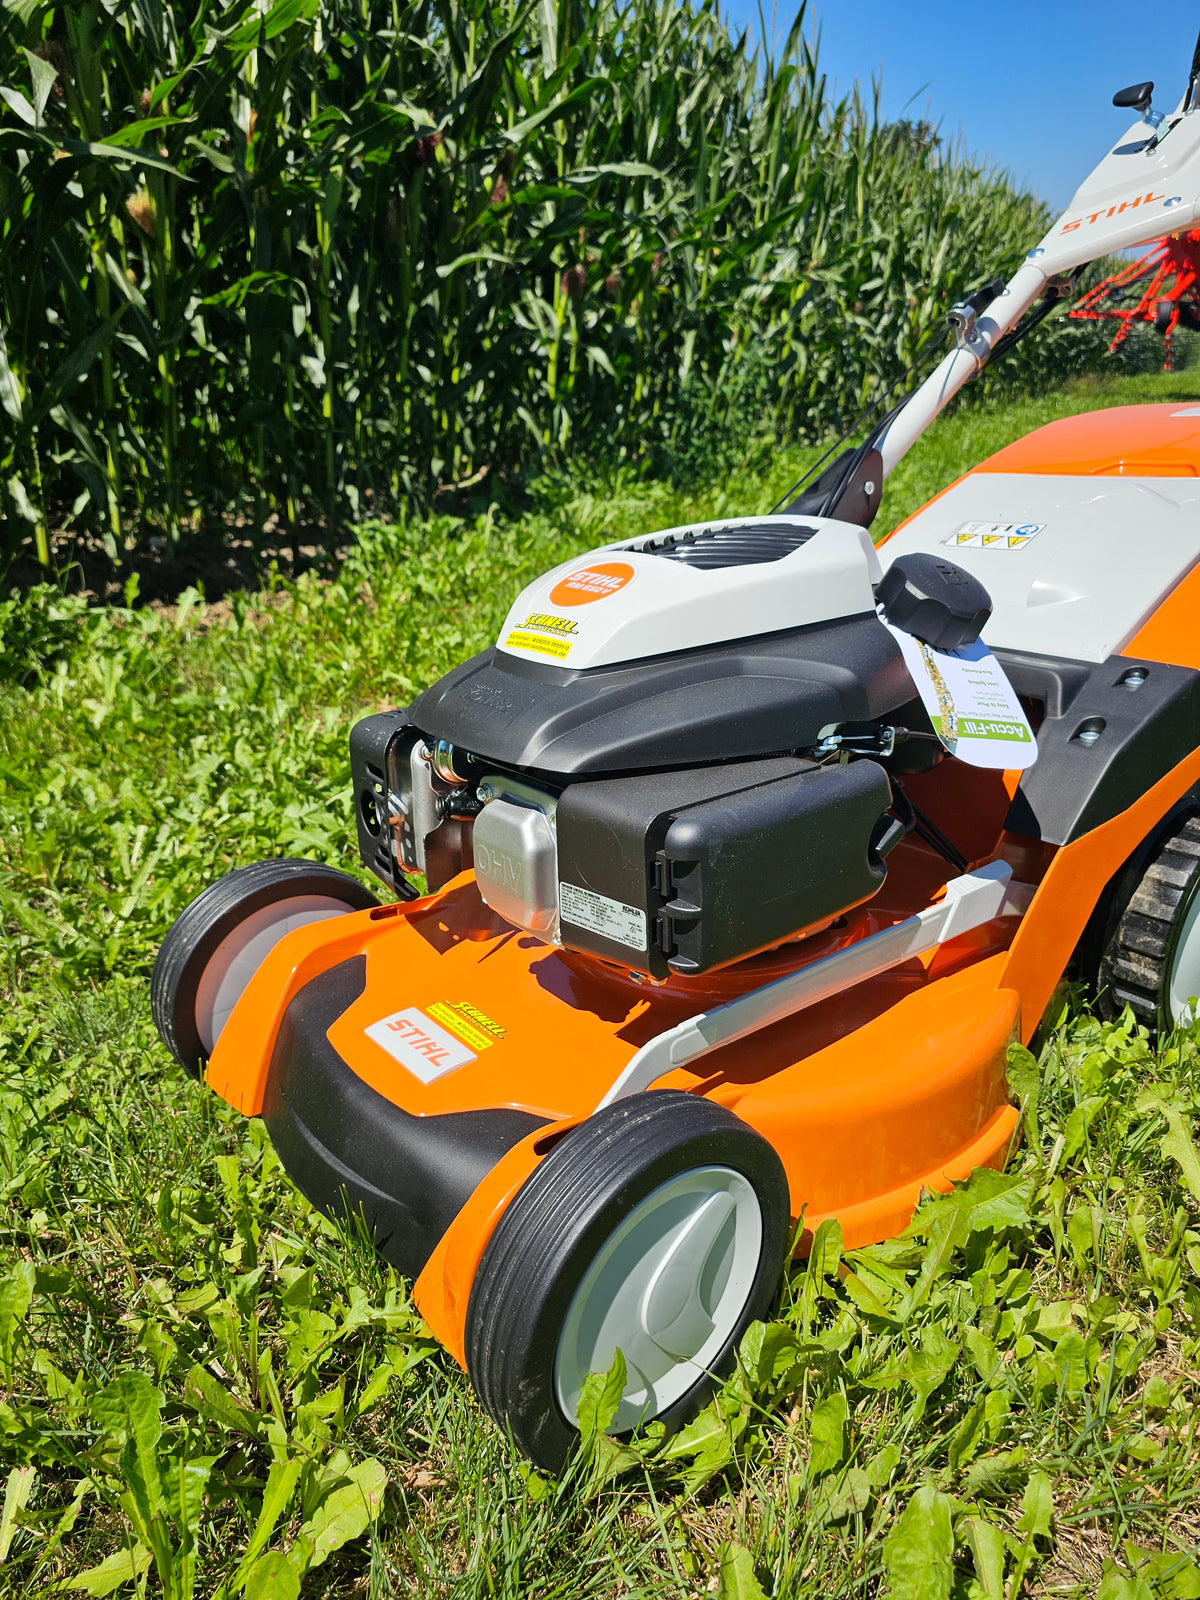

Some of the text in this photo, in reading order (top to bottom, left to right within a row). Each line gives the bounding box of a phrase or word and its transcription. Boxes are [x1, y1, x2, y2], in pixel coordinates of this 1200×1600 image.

[1059, 192, 1165, 236] STIHL
[568, 571, 625, 589] STIHL
[515, 613, 579, 635] SCHNELL
[476, 844, 522, 897] OHV
[622, 905, 642, 916] KOHLER
[444, 1000, 507, 1039] SCHNELL
[385, 1019, 451, 1067] STIHL
